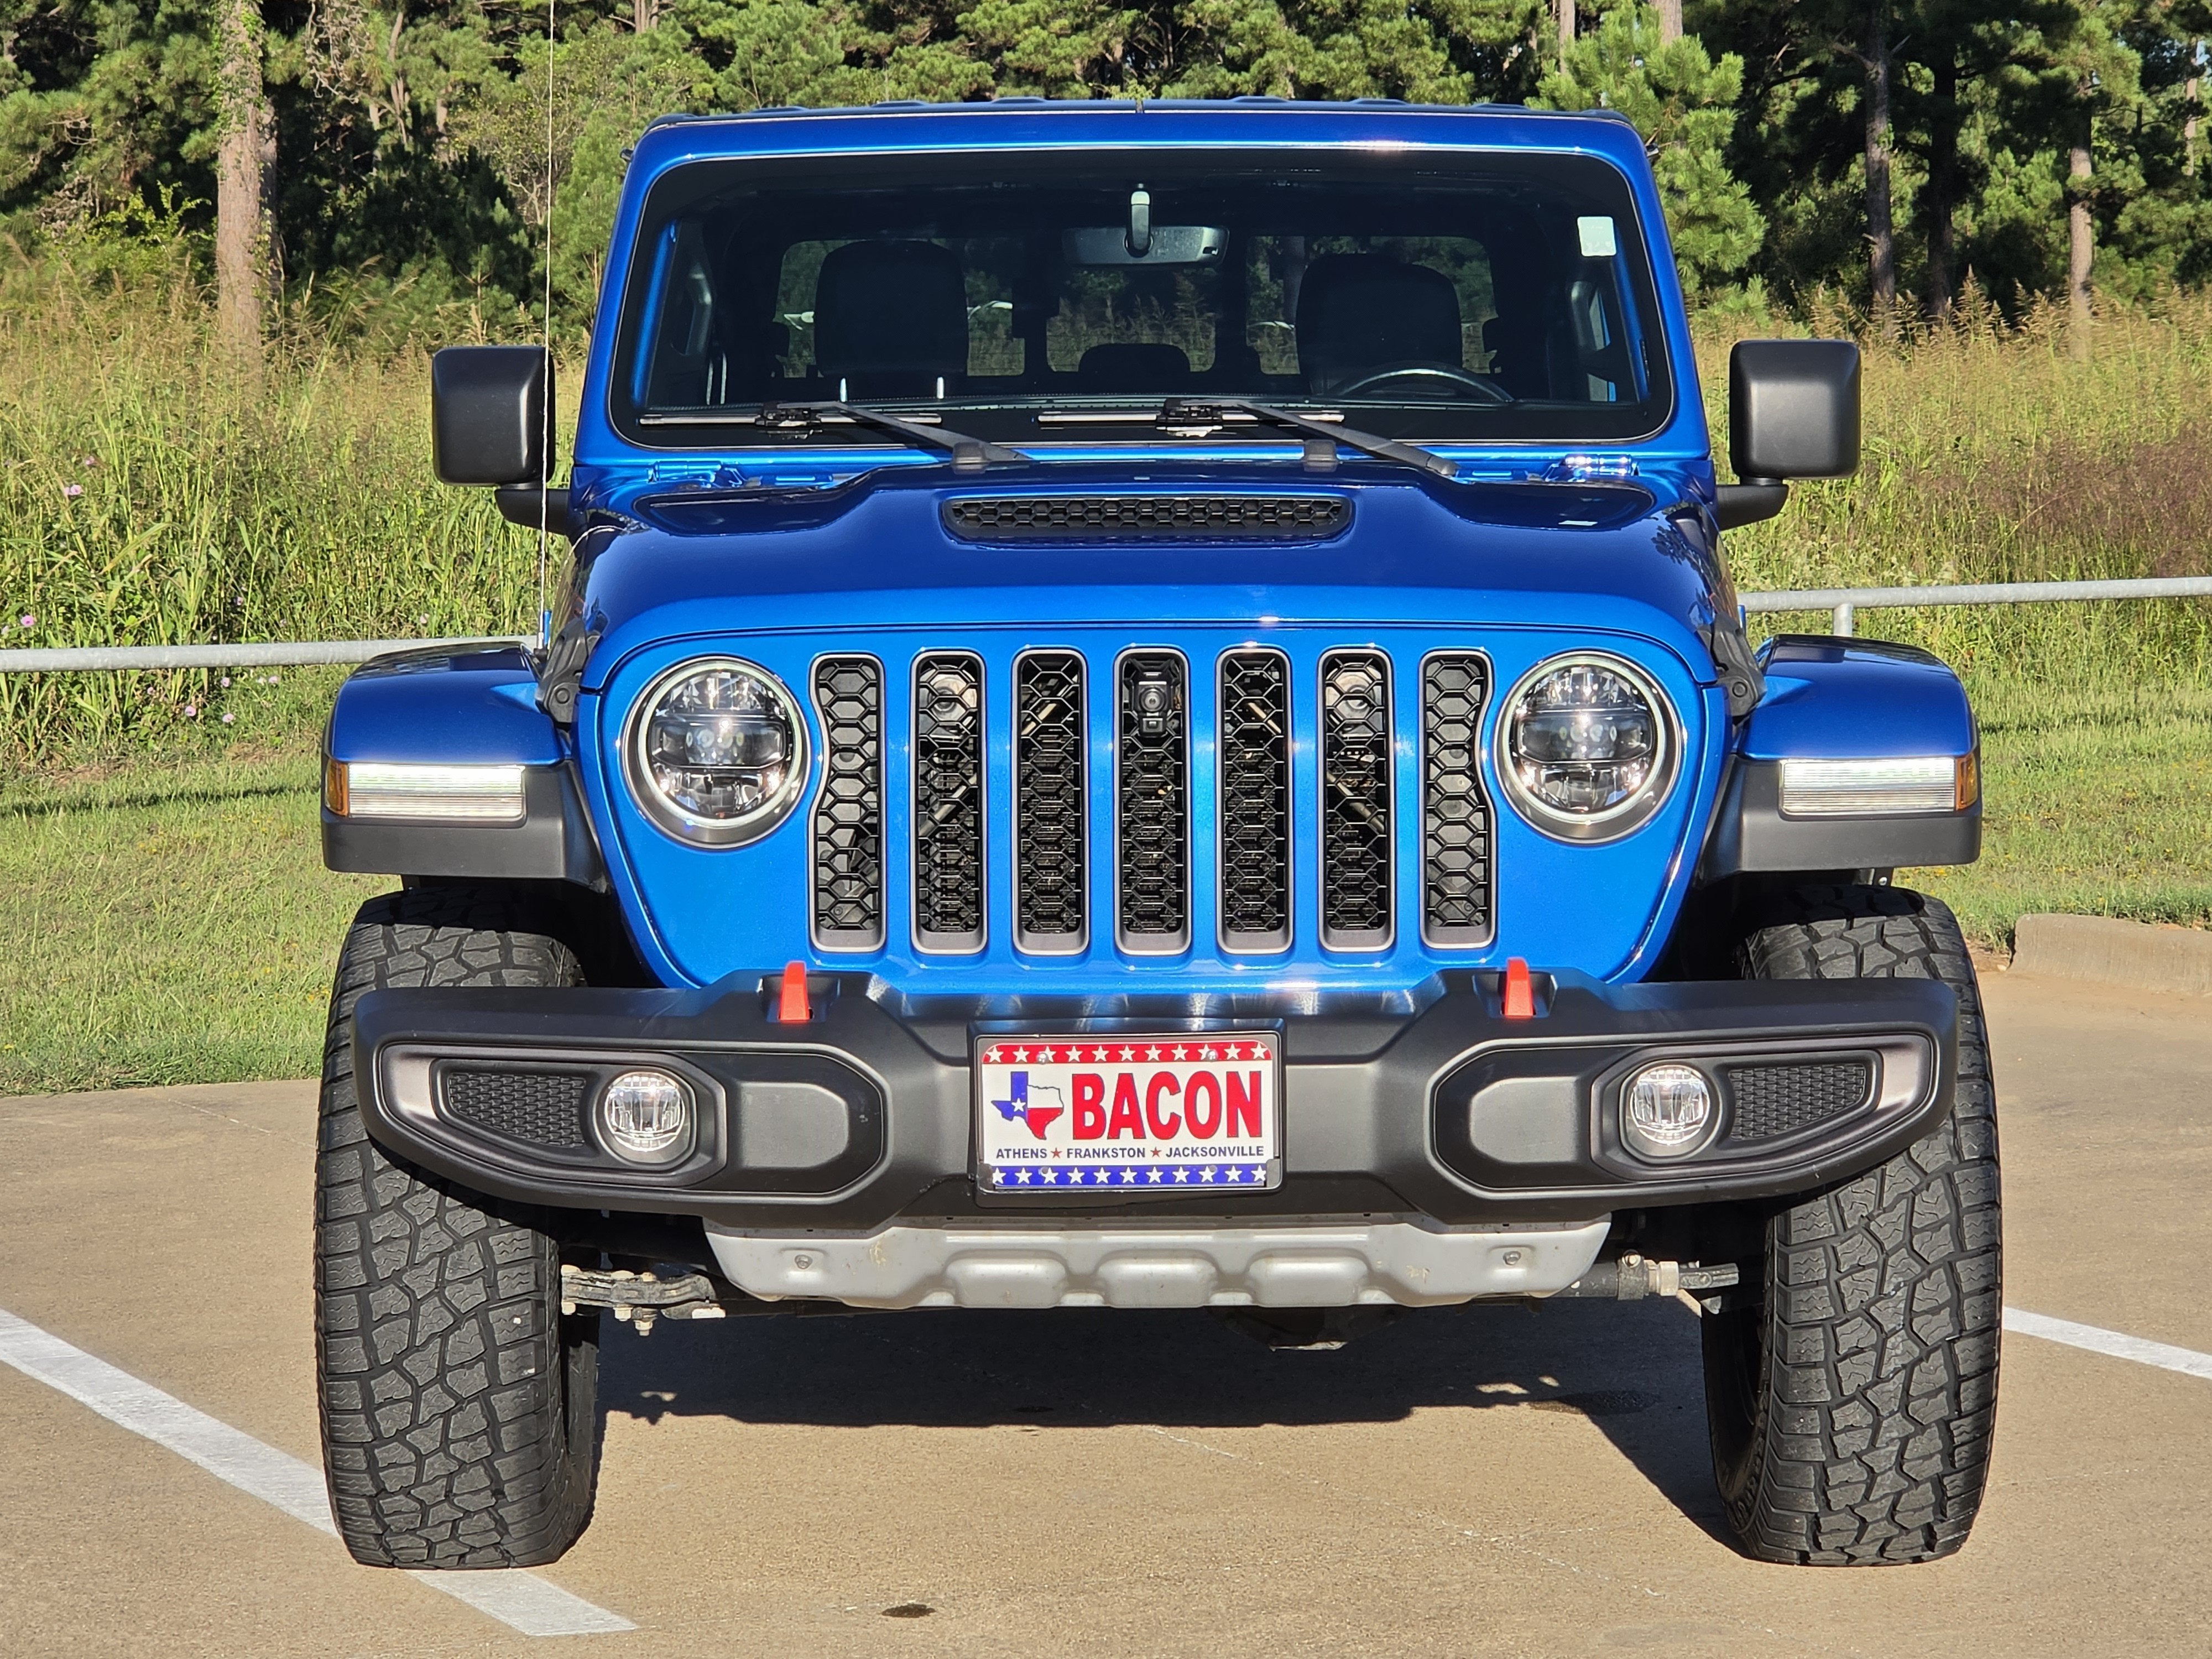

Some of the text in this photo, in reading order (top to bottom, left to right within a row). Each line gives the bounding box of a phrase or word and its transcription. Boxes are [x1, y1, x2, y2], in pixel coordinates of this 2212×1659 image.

[1072, 1071, 1262, 1140] BACON
[996, 1146, 1264, 1159] ATHENS FRANKSTON JACKSONVILLE
